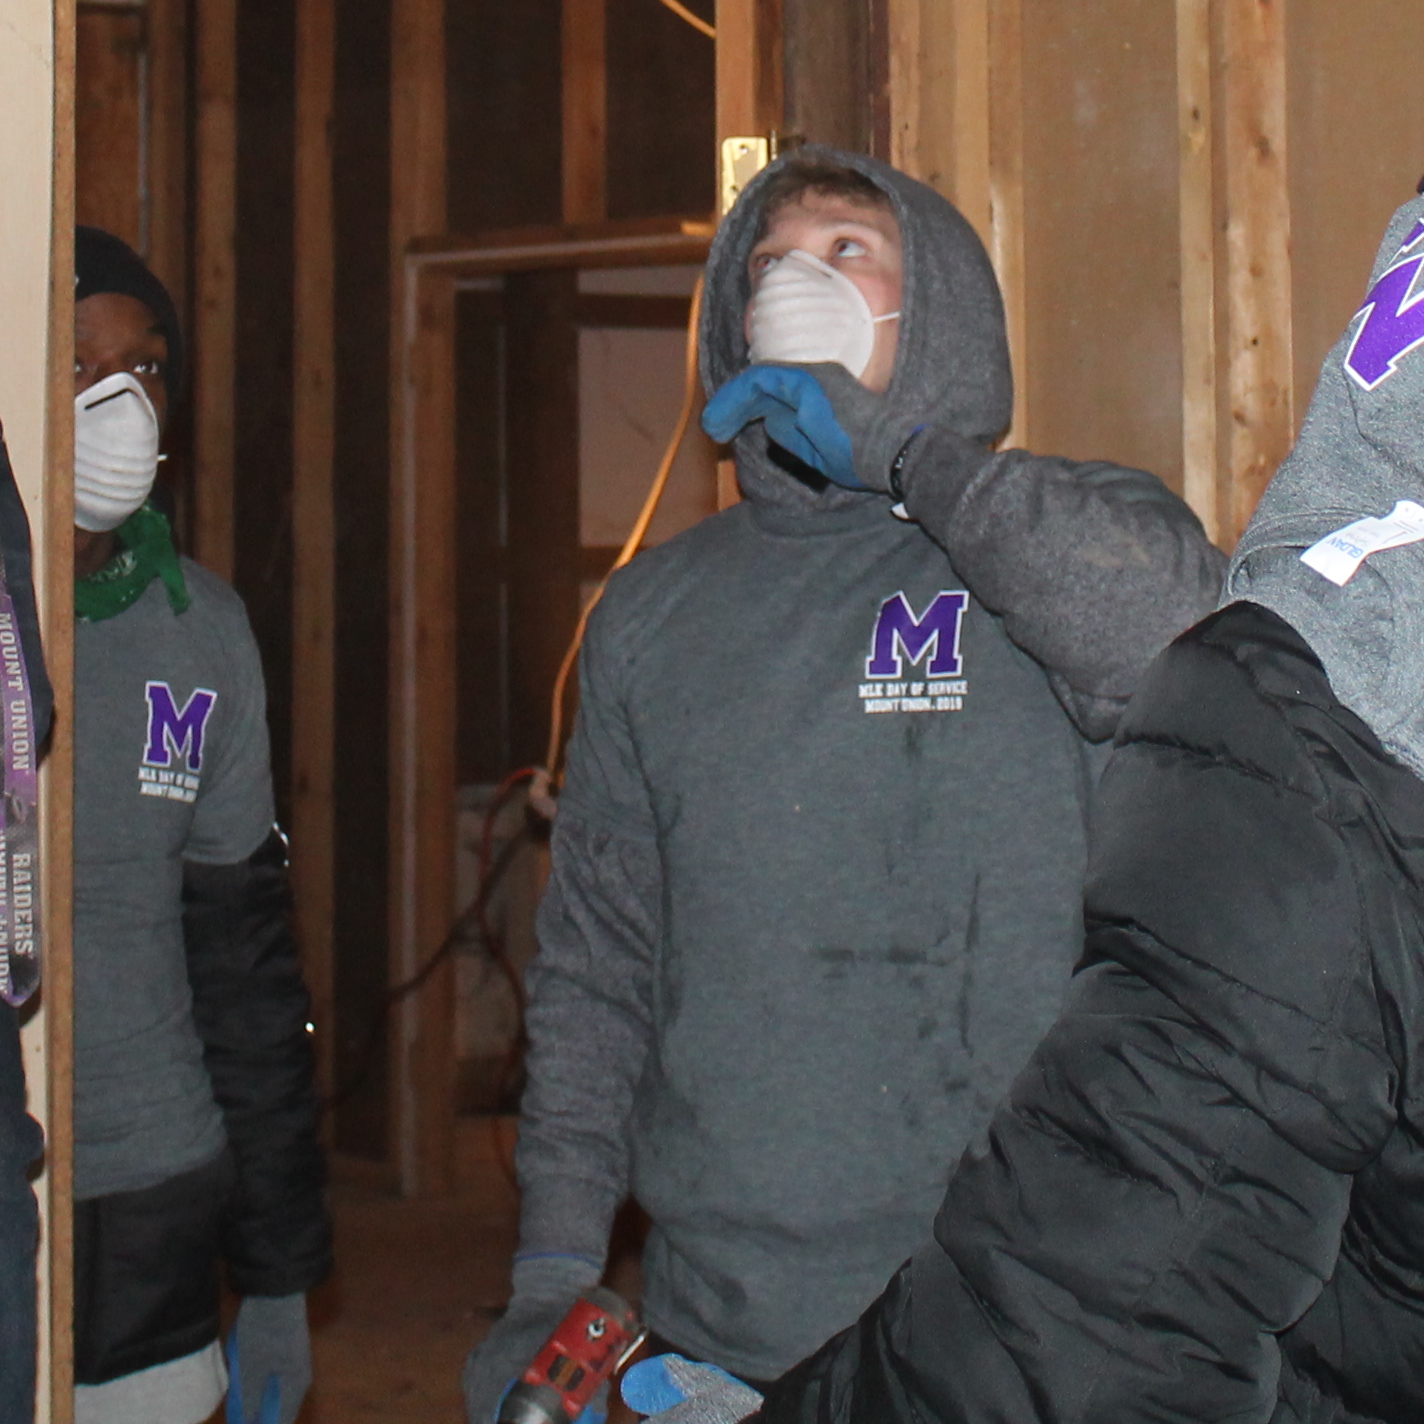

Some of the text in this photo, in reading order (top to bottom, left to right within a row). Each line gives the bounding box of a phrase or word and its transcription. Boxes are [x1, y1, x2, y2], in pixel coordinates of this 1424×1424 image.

[865, 589, 969, 679] M
[142, 680, 218, 774] M
[858, 680, 968, 698] MLK DAY OF SERVICE
[865, 697, 900, 713] MOUNT
[11, 697, 30, 773] UNION
[12, 851, 33, 956] RAIDERS
